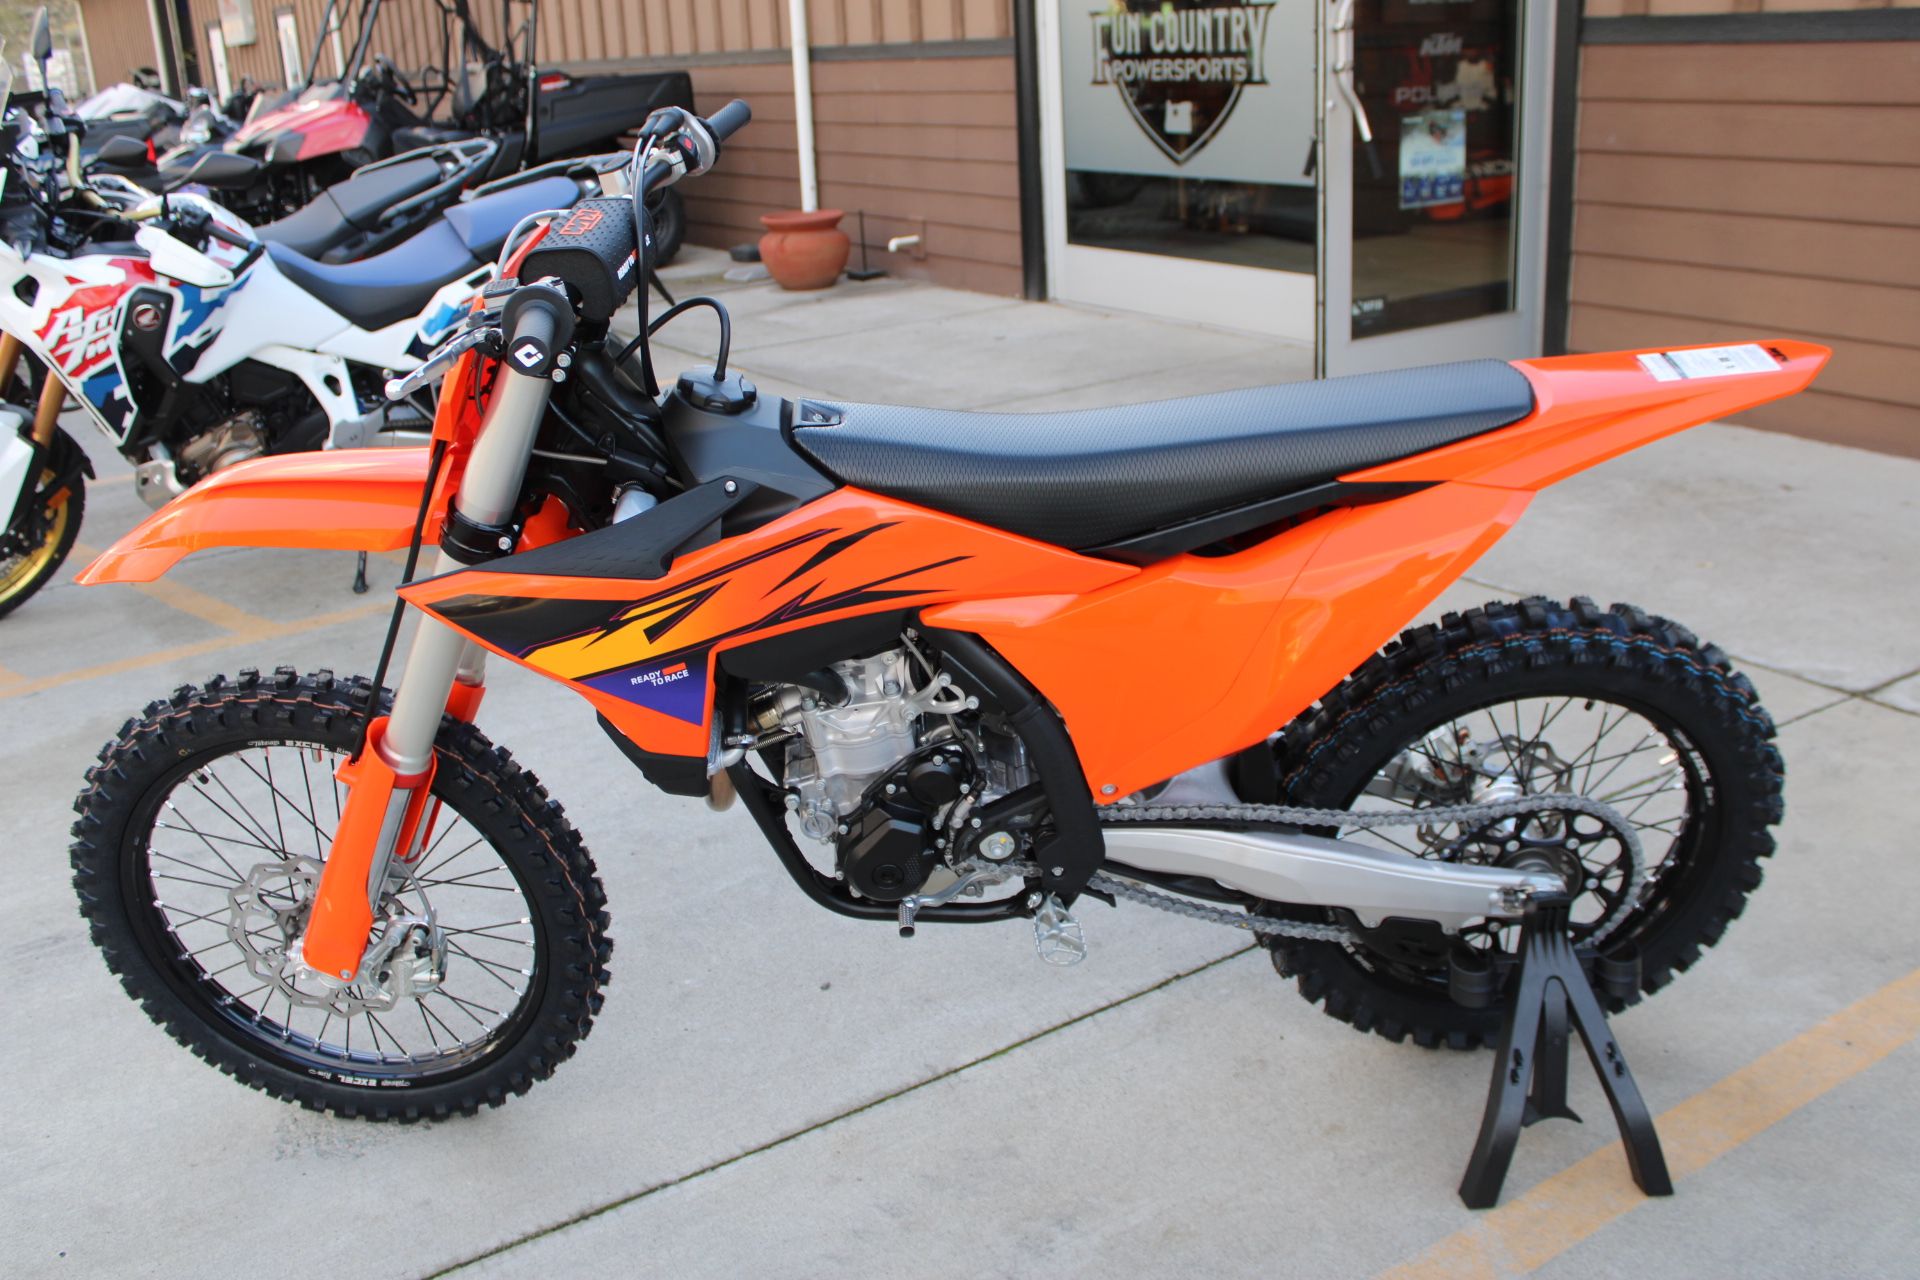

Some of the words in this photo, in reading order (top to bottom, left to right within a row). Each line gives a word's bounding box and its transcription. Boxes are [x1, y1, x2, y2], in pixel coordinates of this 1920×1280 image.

[1090, 11, 1142, 85] FUN
[1150, 5, 1274, 84] COUNTRY
[1110, 57, 1248, 83] POWERSPORTS
[630, 670, 661, 686] READY
[650, 677, 664, 687] TO
[664, 669, 690, 683] RACE
[285, 739, 329, 751] EXCEL
[338, 1074, 377, 1087] EXCEL
